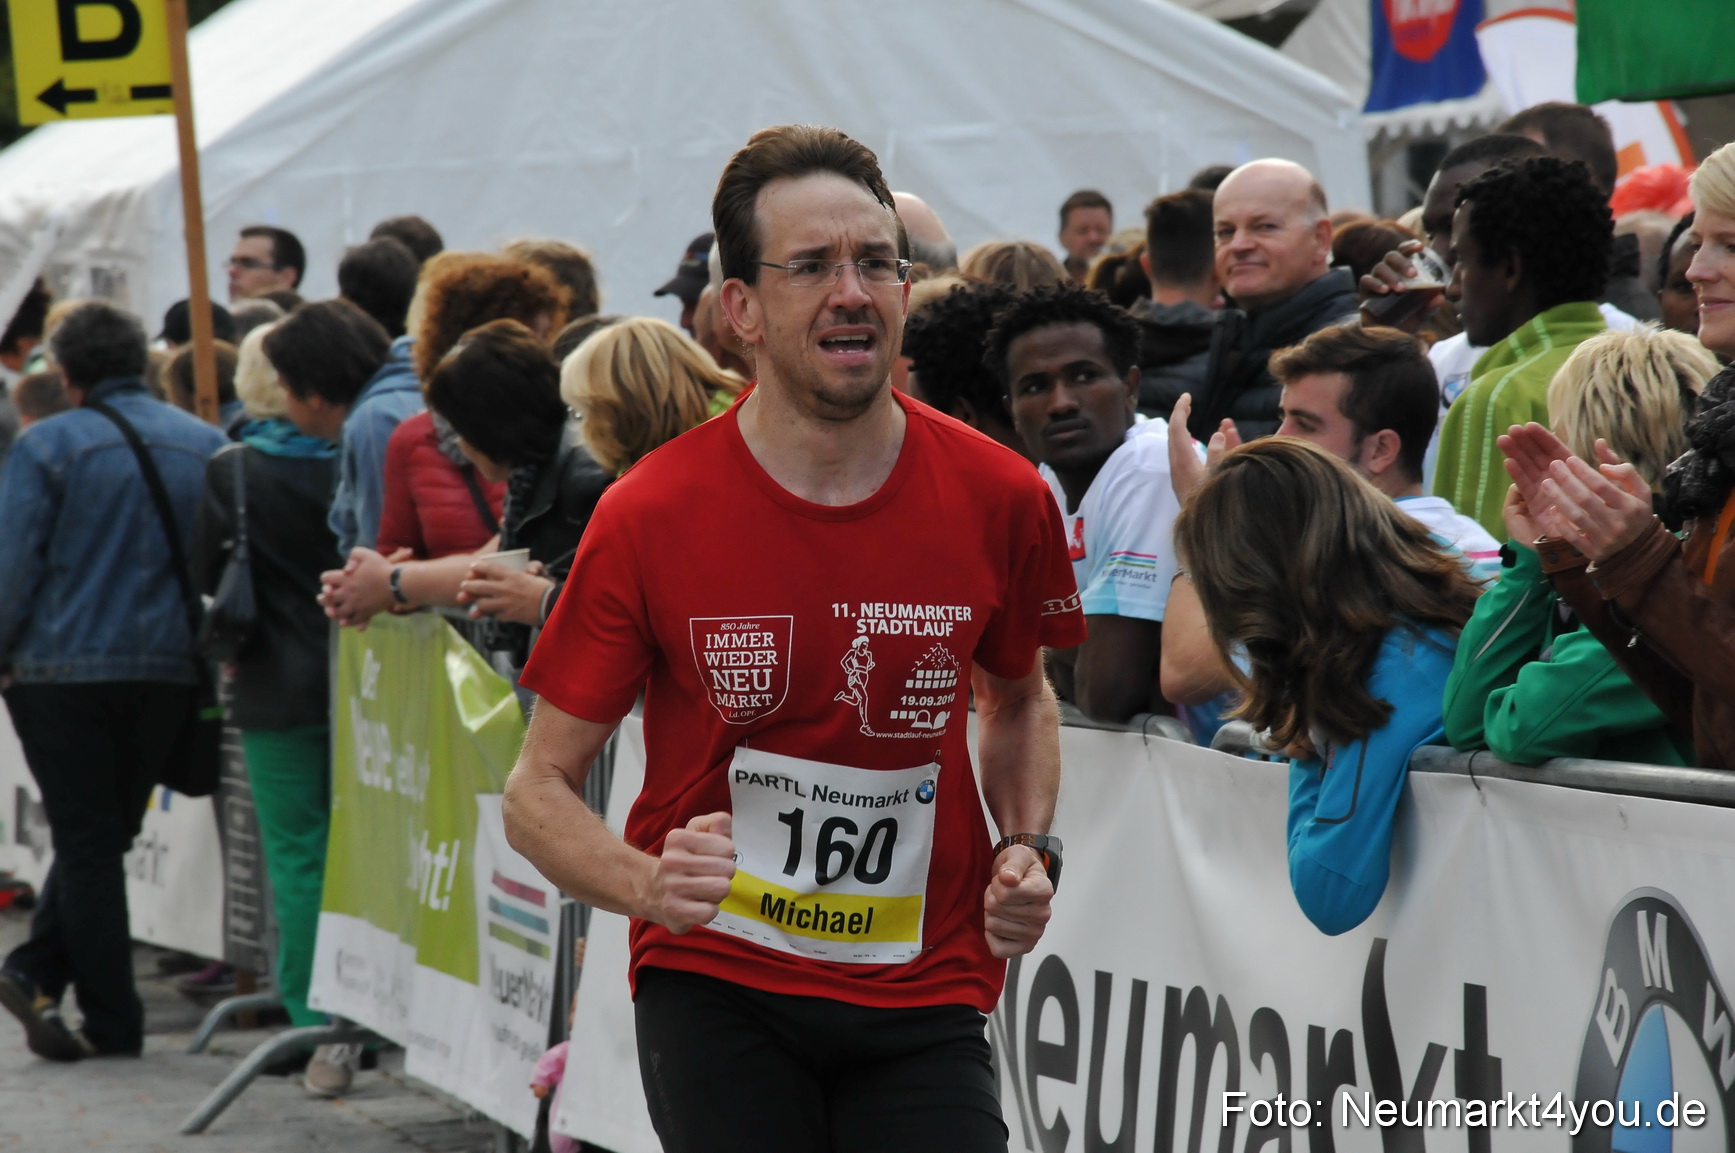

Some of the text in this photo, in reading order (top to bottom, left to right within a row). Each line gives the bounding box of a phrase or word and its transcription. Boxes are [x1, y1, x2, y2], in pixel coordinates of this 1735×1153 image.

[831, 602, 972, 621] 11. NEUMARKTER
[720, 622, 760, 630] 850 Jahre
[856, 619, 954, 637] STADTLAUF
[705, 632, 775, 649] IMMER
[703, 650, 778, 667] WIEDER
[709, 668, 773, 691] NEU
[715, 692, 773, 708] MARKT
[735, 769, 909, 809] PARTL Neumarkt
[778, 807, 899, 886] 160
[760, 892, 874, 935] Michael
